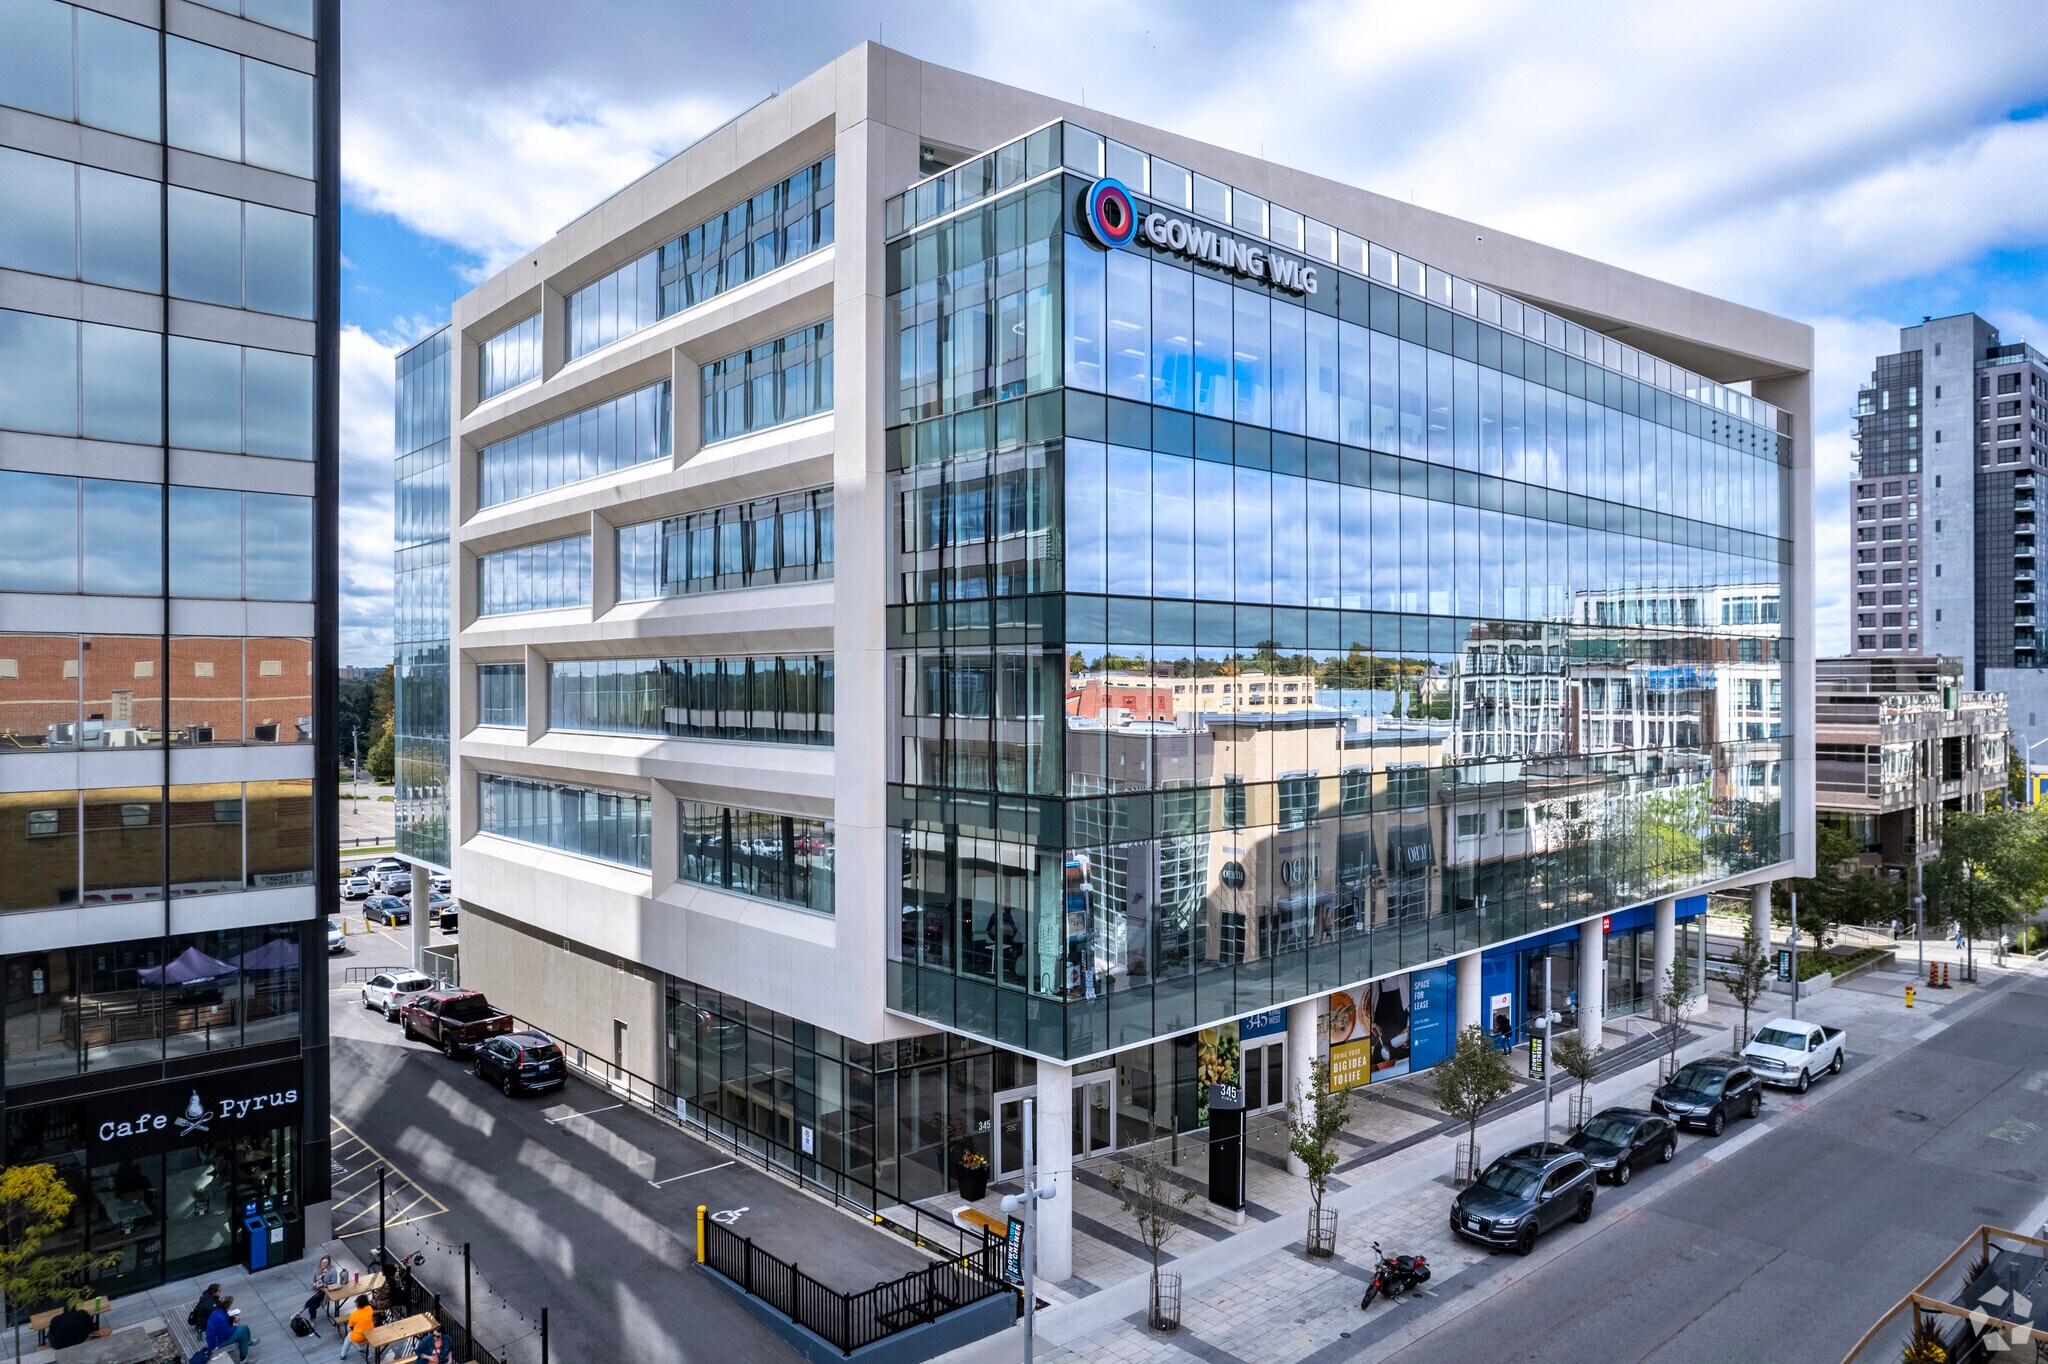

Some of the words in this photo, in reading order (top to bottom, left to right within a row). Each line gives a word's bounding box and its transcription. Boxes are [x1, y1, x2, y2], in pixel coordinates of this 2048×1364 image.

[1144, 212, 1264, 277] GOWLING
[1268, 253, 1318, 294] WLG
[1414, 979, 1430, 991] SPACE
[1414, 991, 1425, 1000] FOR
[1414, 1000, 1429, 1011] LEASE
[1246, 1013, 1268, 1030] 345
[1268, 1015, 1281, 1025] WEST
[1333, 1051, 1348, 1061] BRING
[1348, 1048, 1361, 1057] YOUR
[1333, 1060, 1347, 1073] BIG
[1349, 1056, 1367, 1070] IDEA
[1333, 1074, 1343, 1086] TO
[1344, 1070, 1361, 1083] LIFE
[1220, 1083, 1237, 1099] 345
[99, 1113, 168, 1142] Cafe
[219, 1089, 298, 1119] Pyrus
[978, 1119, 991, 1131] 345
[1007, 1221, 1017, 1271] DOWNTOWN
[1012, 1223, 1022, 1274] KITCHENER
